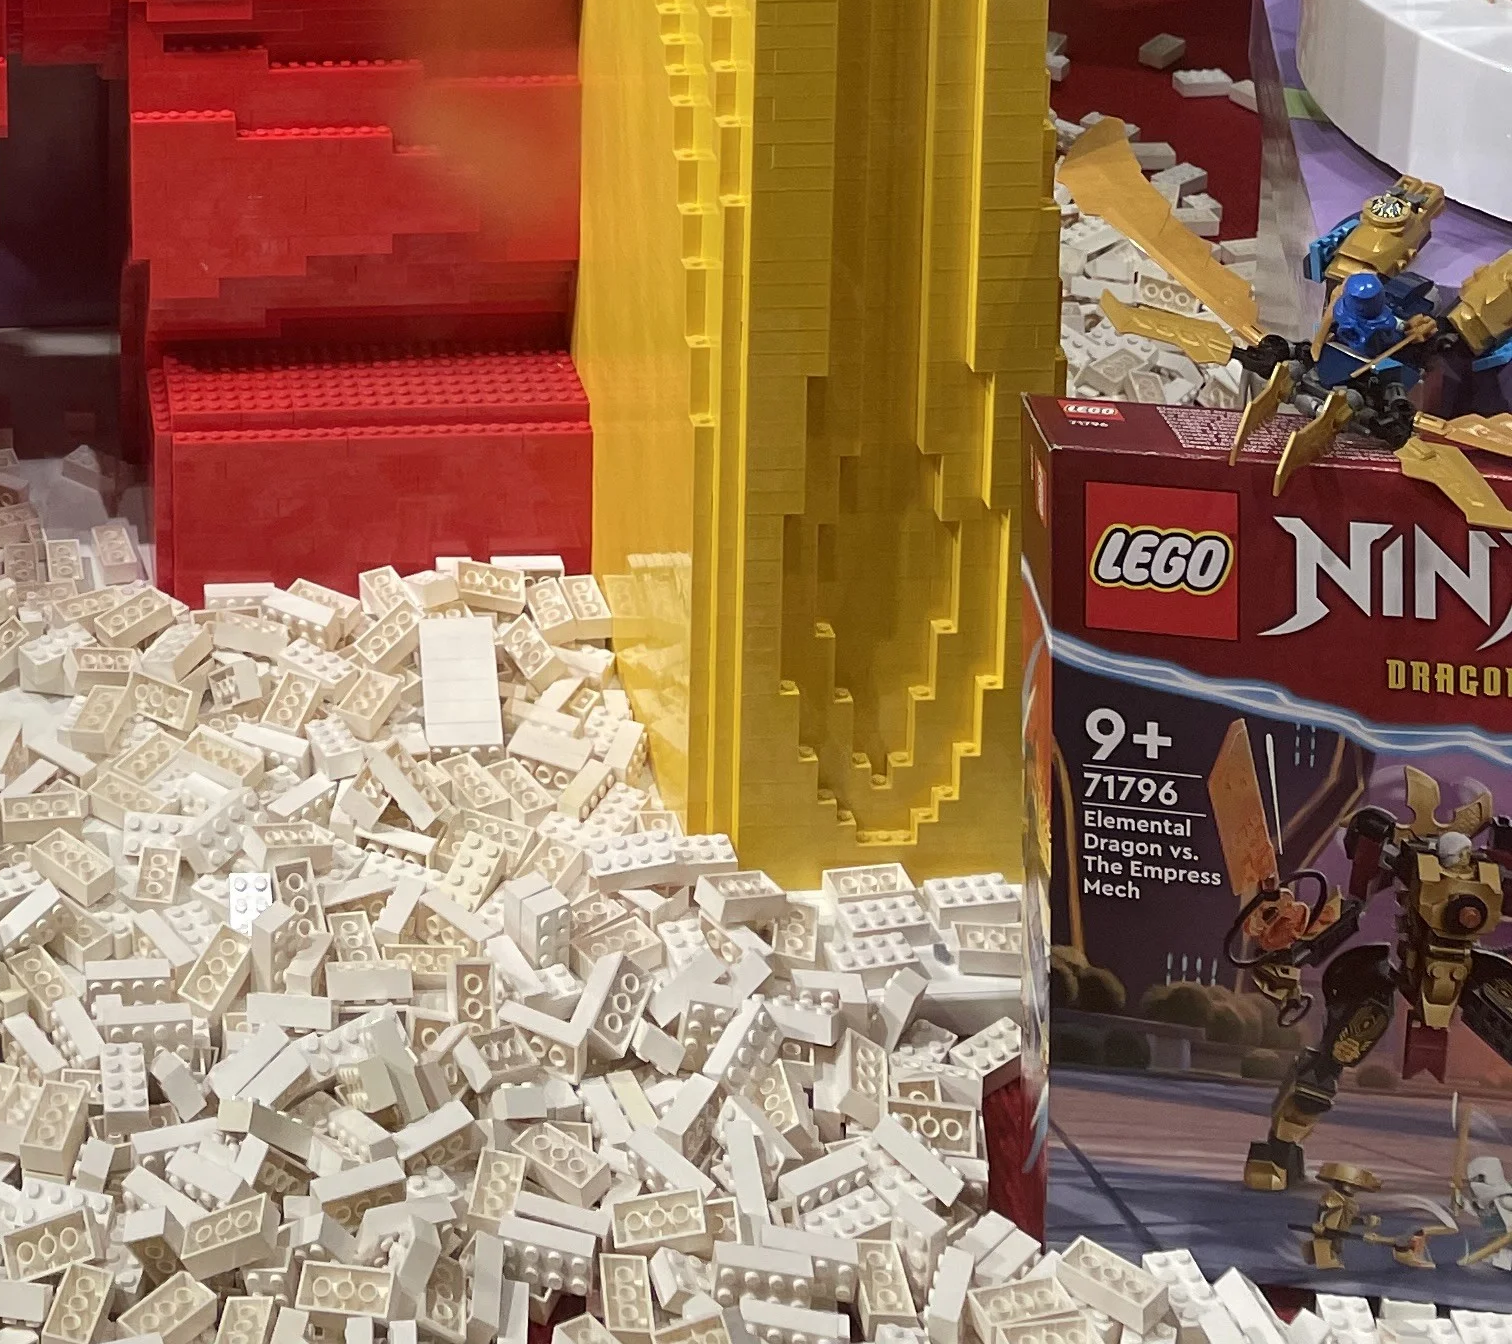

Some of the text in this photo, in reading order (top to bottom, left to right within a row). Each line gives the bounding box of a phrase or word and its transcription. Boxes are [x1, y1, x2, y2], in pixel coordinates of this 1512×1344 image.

[1095, 528, 1229, 591] LEGO
[1085, 708, 1172, 760] 9+
[1084, 772, 1178, 805] 71796
[1084, 810, 1192, 837] Elemental
[1084, 833, 1199, 861] Dragon vs.
[1083, 855, 1222, 886] The Empress
[1083, 878, 1140, 900] Mech
